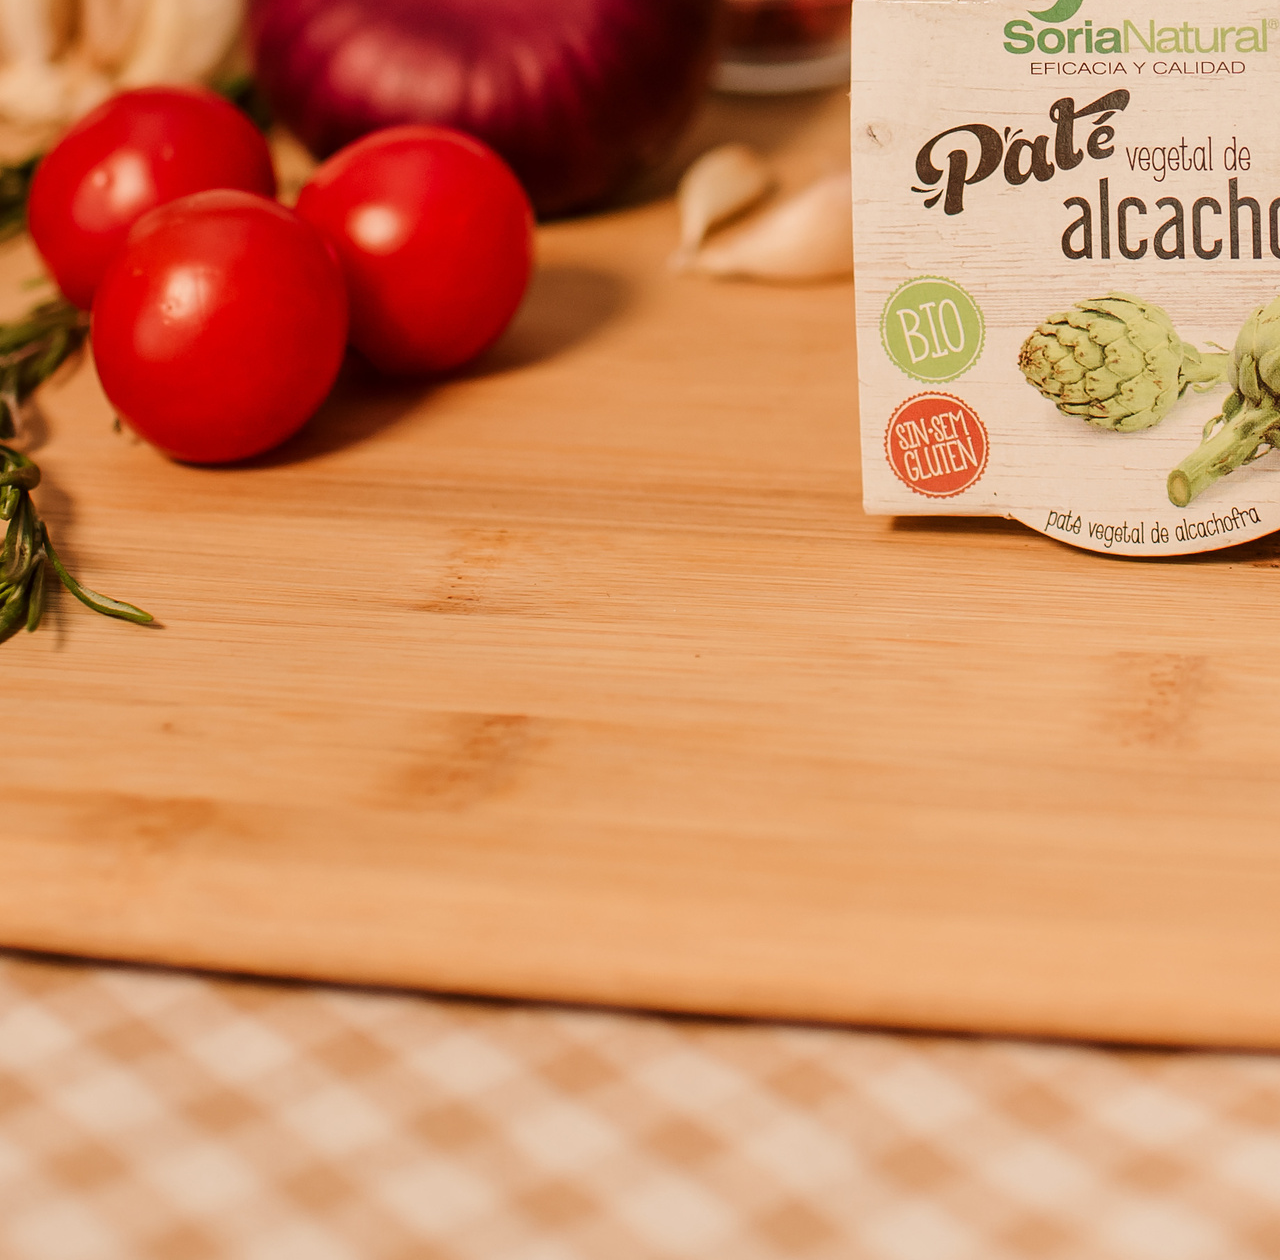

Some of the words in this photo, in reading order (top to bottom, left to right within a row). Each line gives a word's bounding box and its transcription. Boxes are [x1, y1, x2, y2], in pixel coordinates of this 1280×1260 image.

[1029, 61, 1127, 76] EFICACIA
[1132, 61, 1146, 75] Y
[1152, 60, 1246, 75] CALIDAD
[912, 88, 1130, 216] Paté
[1125, 136, 1214, 183] vegetal
[1223, 136, 1251, 172] de
[895, 298, 965, 364] BIO
[903, 436, 978, 482] GLUTEN
[1088, 520, 1145, 548] vegetal
[1150, 521, 1170, 544] de
[1174, 506, 1262, 543] alcachofra
